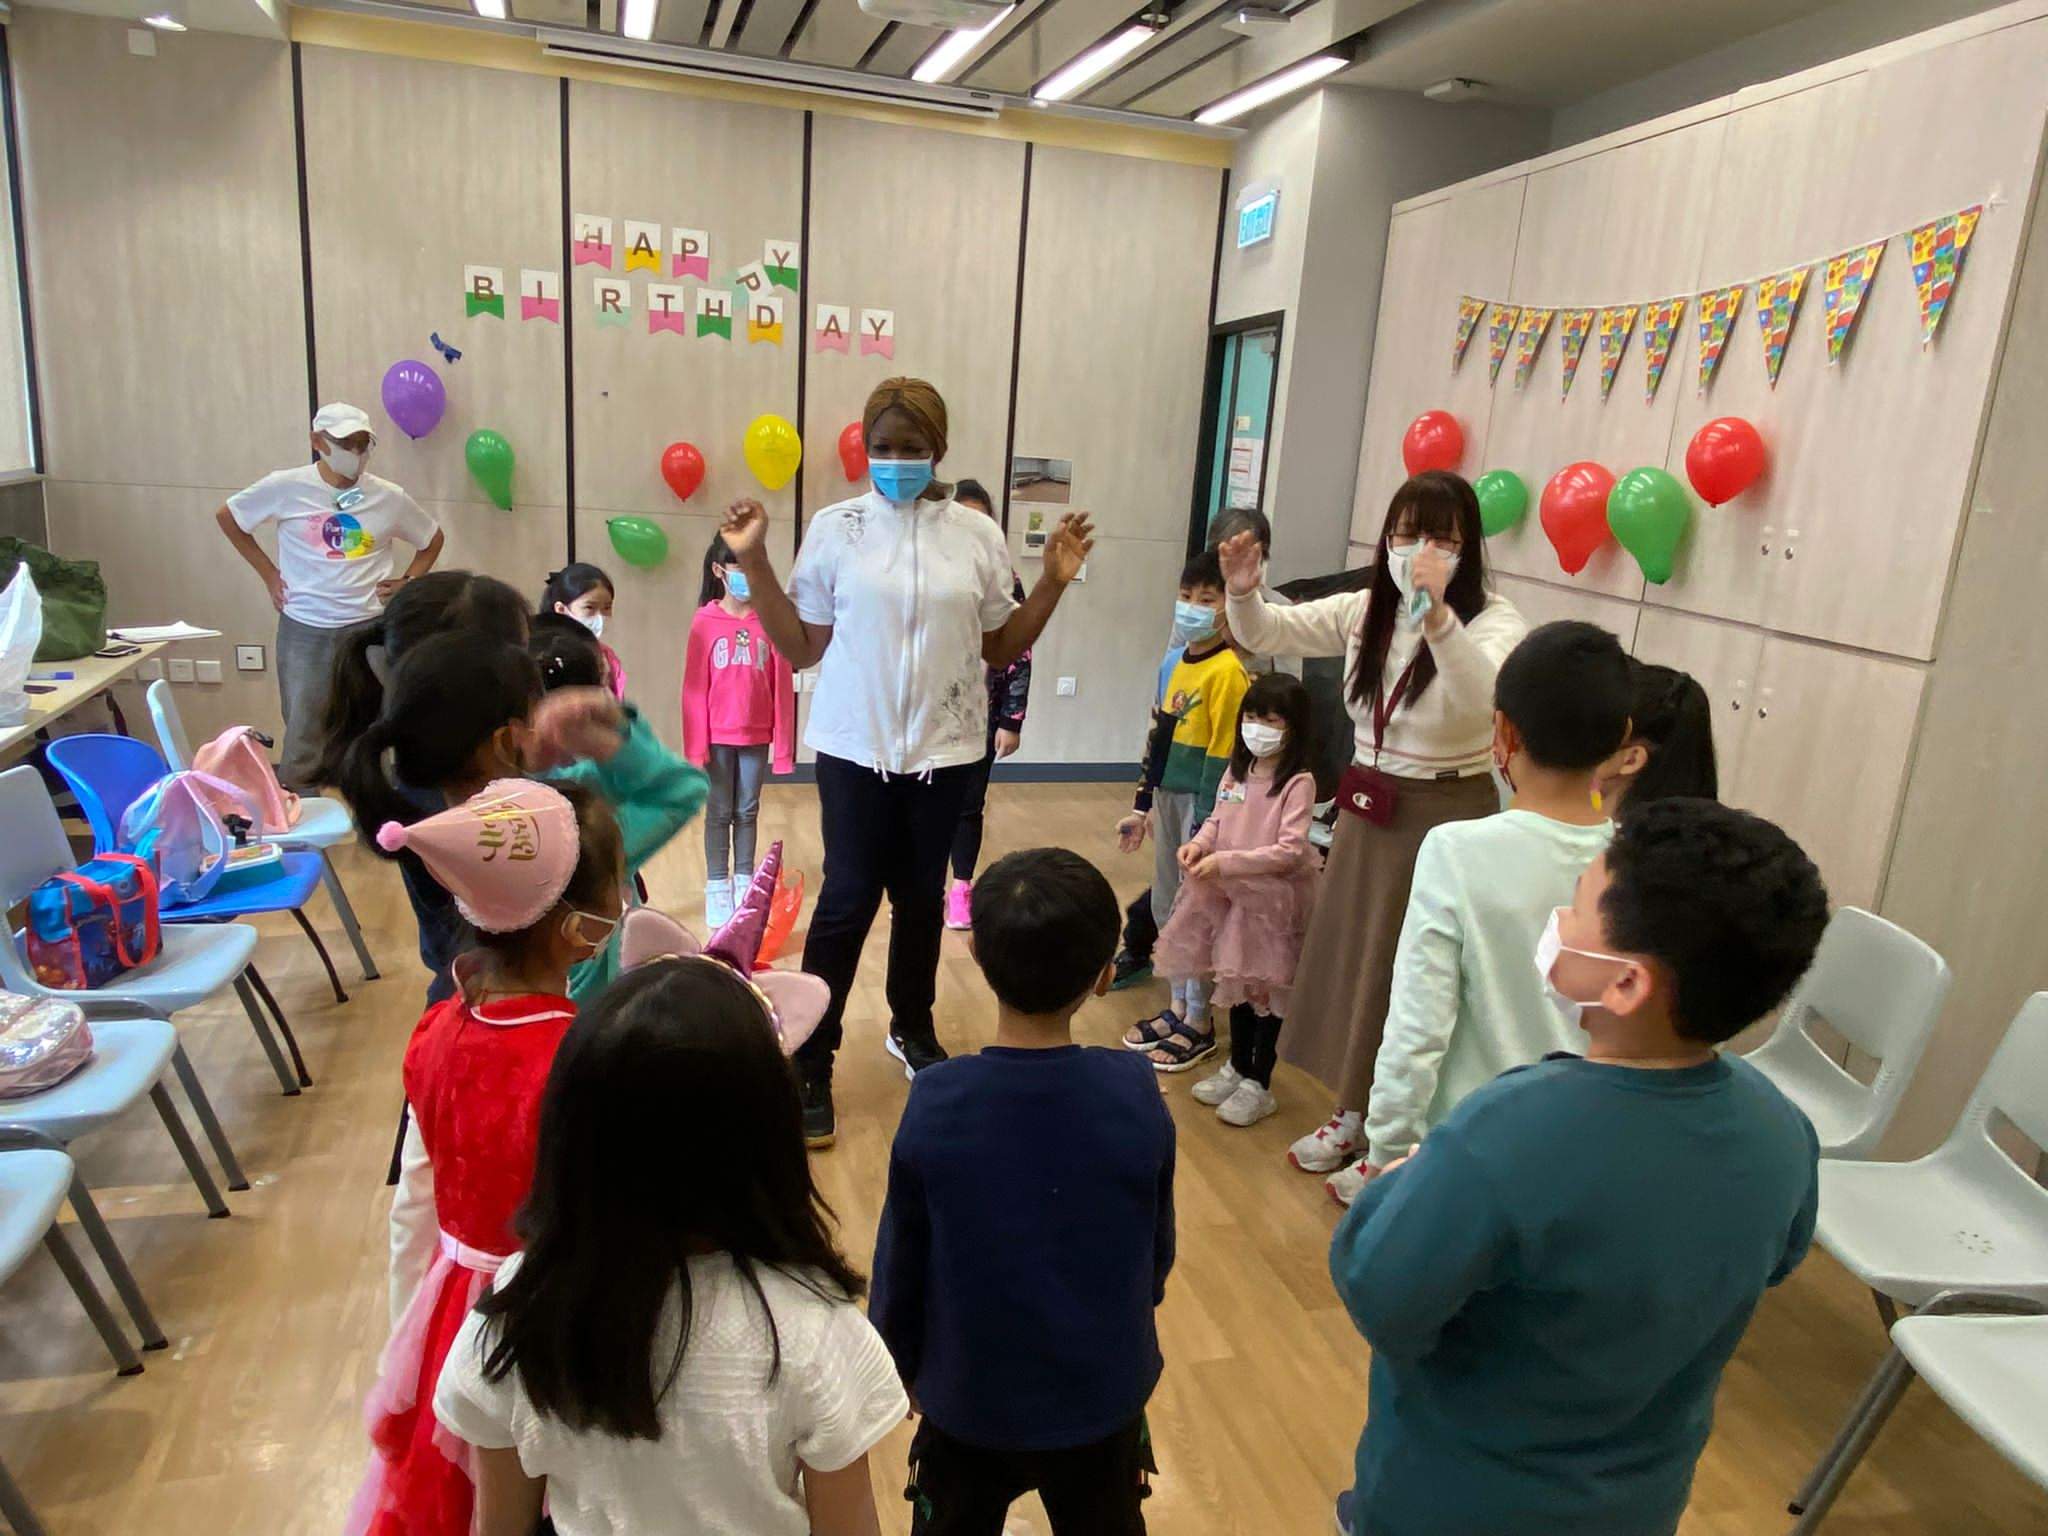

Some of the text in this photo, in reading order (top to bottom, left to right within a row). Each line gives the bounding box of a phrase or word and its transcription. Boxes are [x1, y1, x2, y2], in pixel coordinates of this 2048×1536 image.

[582, 222, 791, 294] HAPPY
[473, 274, 888, 342] BIRTHDAY
[713, 635, 770, 672] GAP
